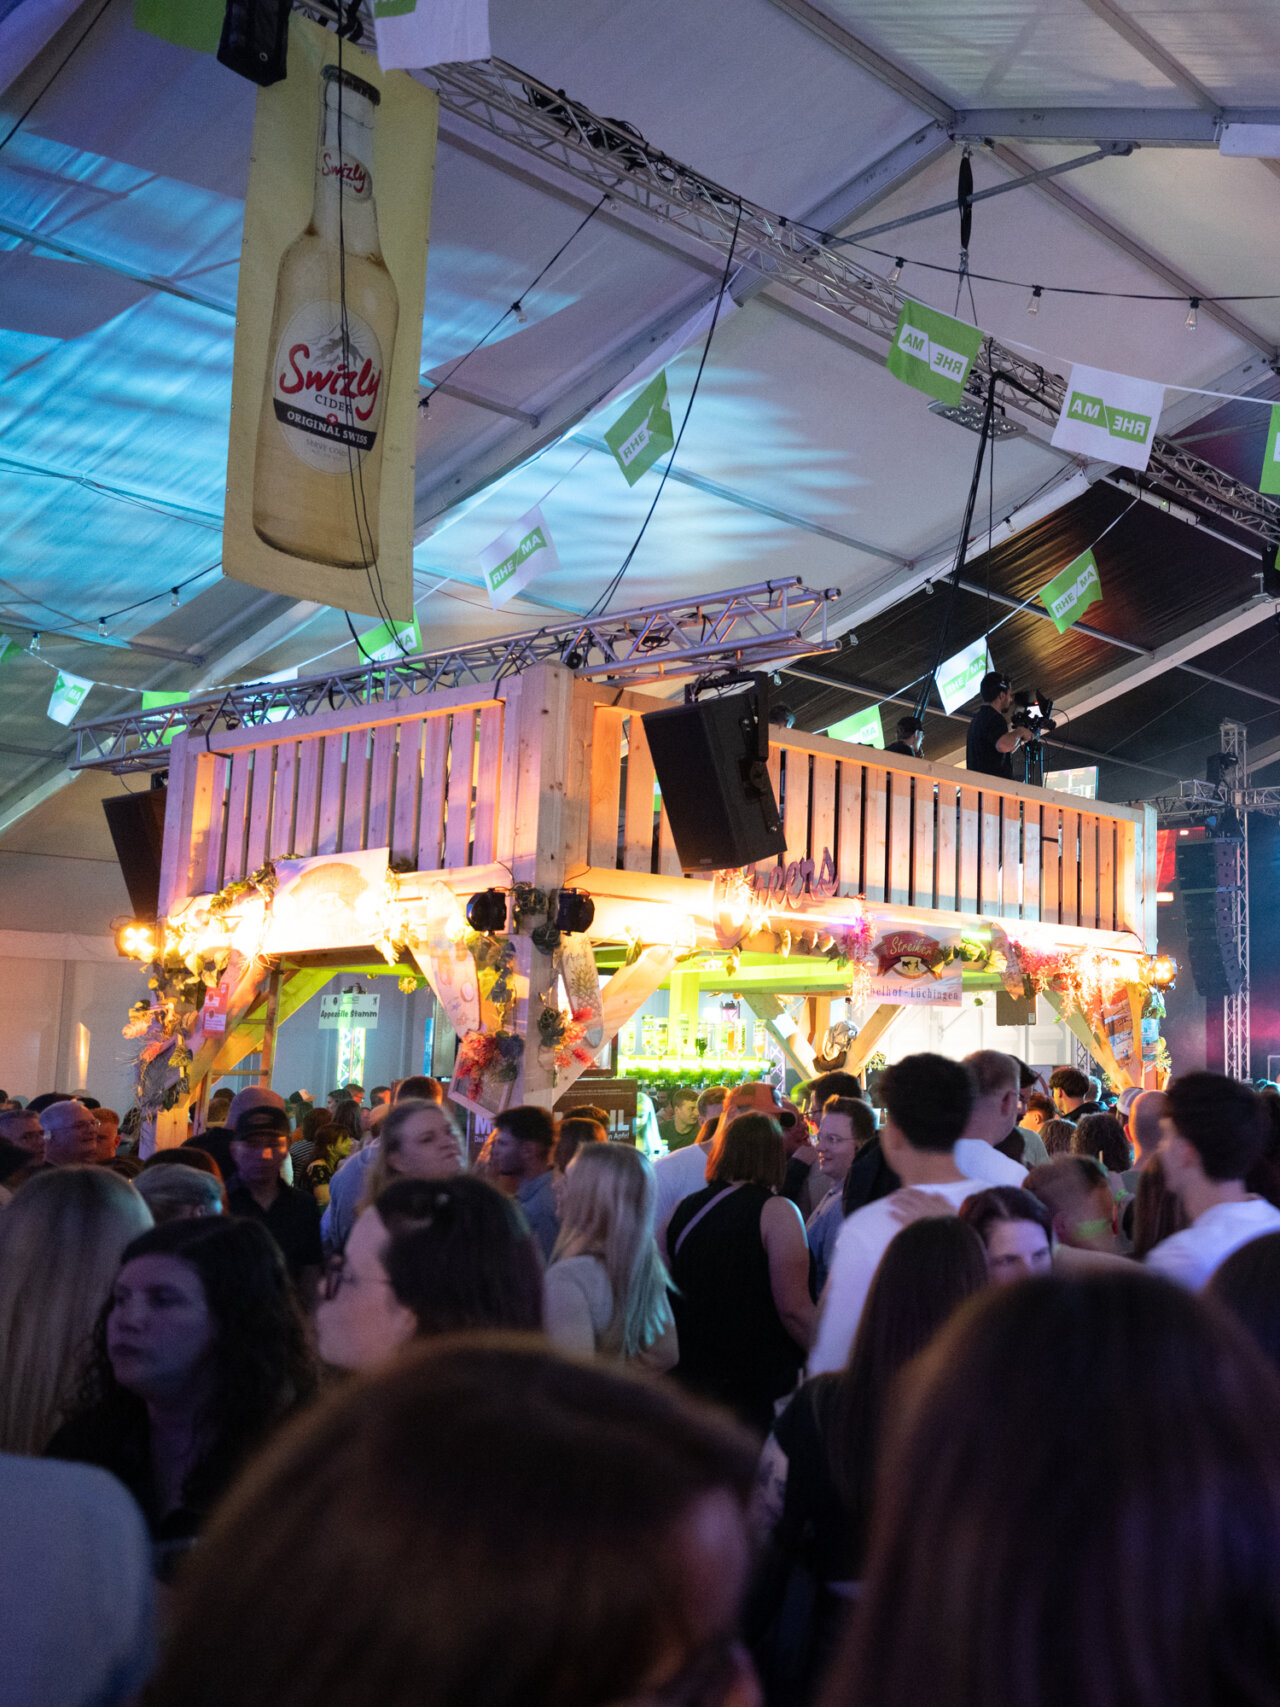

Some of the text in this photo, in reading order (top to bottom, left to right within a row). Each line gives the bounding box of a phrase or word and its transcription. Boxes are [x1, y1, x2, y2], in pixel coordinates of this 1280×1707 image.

[321, 152, 367, 193] Swizly
[279, 343, 382, 422] Swizly
[314, 394, 354, 415] CIDER
[286, 410, 369, 446] ORIGINAL SWISS
[350, 1009, 378, 1018] Stamm
